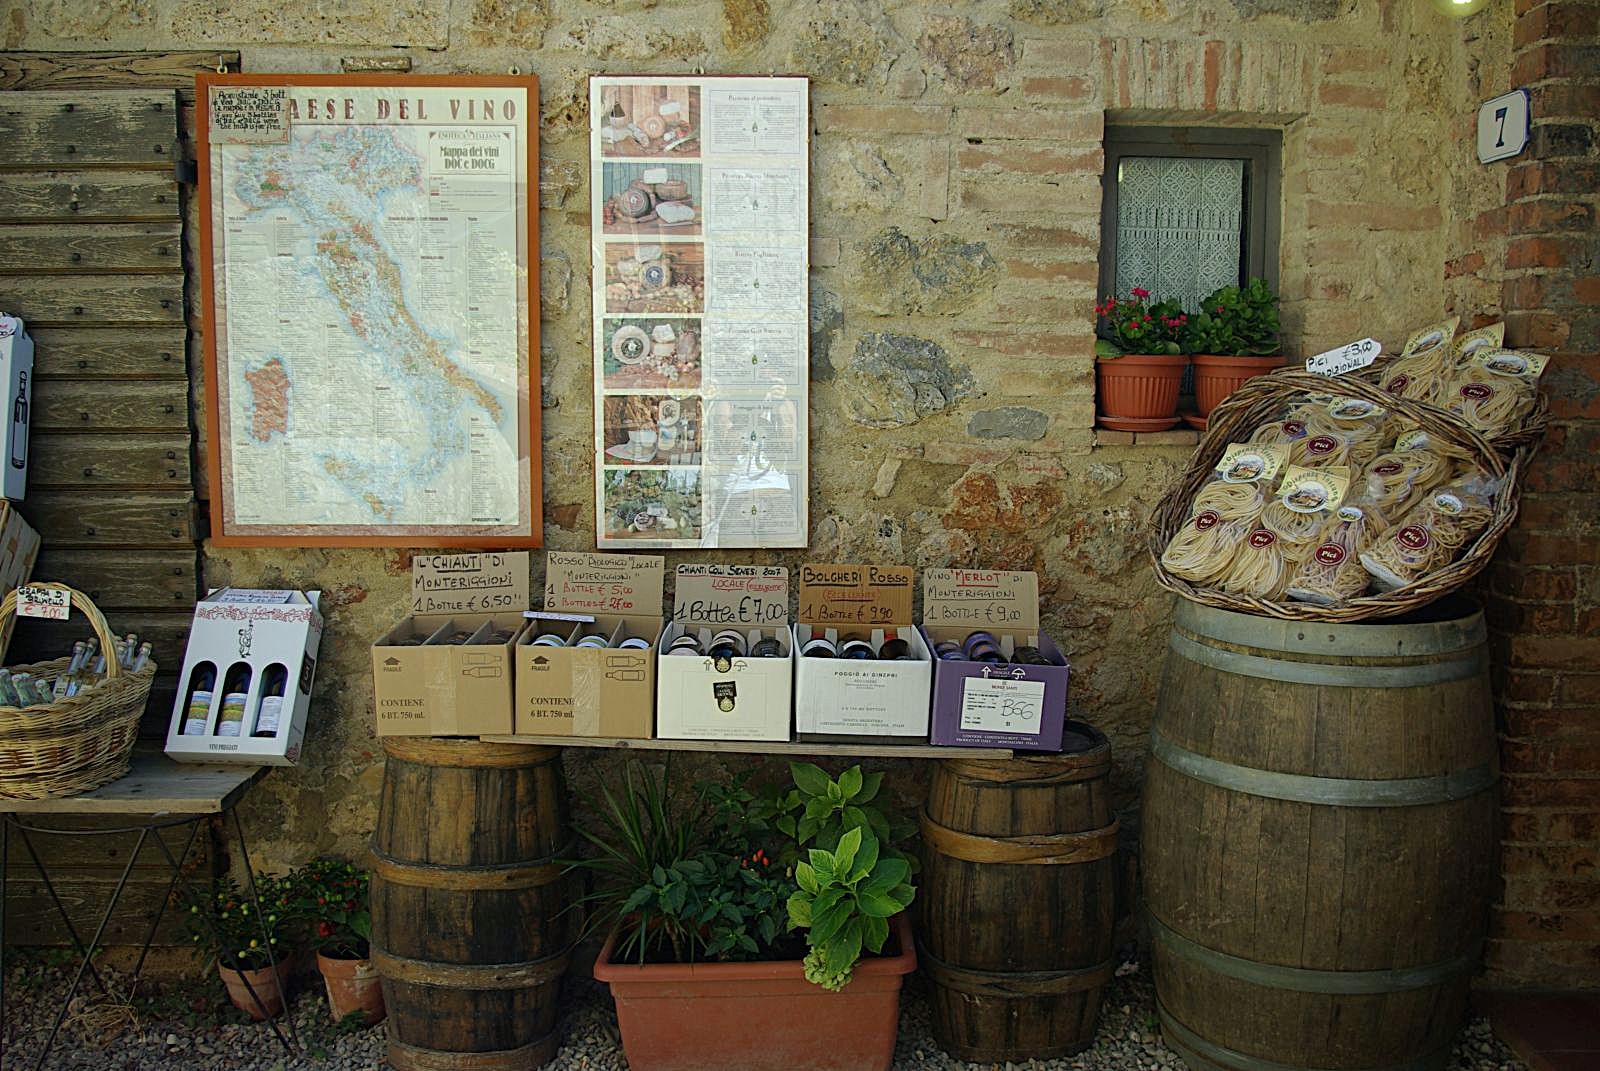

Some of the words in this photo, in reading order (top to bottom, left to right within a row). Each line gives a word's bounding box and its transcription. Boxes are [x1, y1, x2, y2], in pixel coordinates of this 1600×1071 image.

[290, 99, 354, 120] AESE
[377, 98, 427, 120] DEL
[450, 98, 516, 120] VINO
[1496, 107, 1508, 148] 7
[440, 146, 468, 159] Mappa
[469, 146, 482, 157] dei
[484, 146, 499, 157] vini
[444, 159, 462, 169] DOC
[471, 159, 494, 169] DOCG
[1404, 531, 1420, 542] Pici
[492, 556, 504, 566] DI
[549, 552, 583, 566] ROSSO
[1322, 550, 1336, 559] Pici
[416, 572, 512, 588] MONTERIGGIONI
[803, 567, 861, 582] BOLGHERI
[869, 567, 908, 582] ROSSO
[928, 570, 950, 580] VINO
[547, 584, 554, 594] 1
[597, 584, 605, 595] €
[712, 579, 745, 588] LOCALE
[928, 585, 1015, 598] MONTERIGGIONI
[413, 598, 423, 612] 1
[427, 599, 462, 612] BOTTLE
[466, 596, 477, 612] €
[547, 598, 555, 608] 6
[674, 602, 687, 620] 1
[739, 595, 752, 622] €
[801, 604, 813, 619] 1
[818, 604, 852, 619] BOTTLE
[857, 606, 864, 620] €
[925, 606, 937, 619] 1
[943, 606, 980, 619] BOTTLE
[984, 602, 996, 623] €
